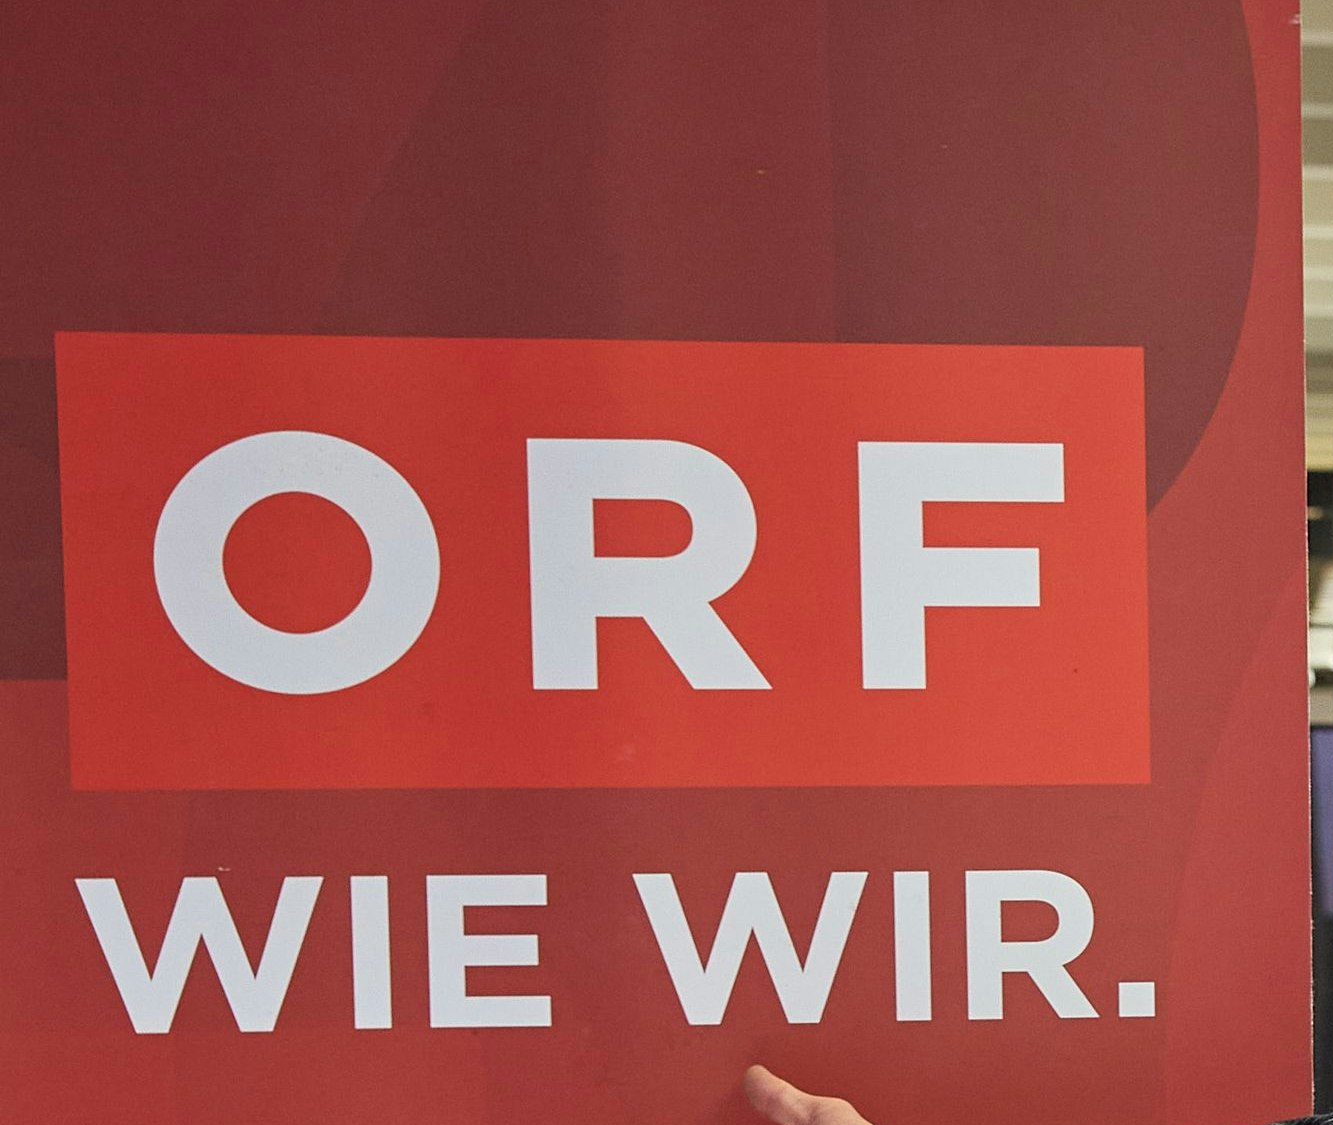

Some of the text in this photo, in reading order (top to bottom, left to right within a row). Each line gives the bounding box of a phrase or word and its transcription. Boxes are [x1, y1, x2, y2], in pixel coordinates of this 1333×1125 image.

[154, 431, 1065, 694] ORF
[75, 870, 1156, 1033] WIE WIR.
